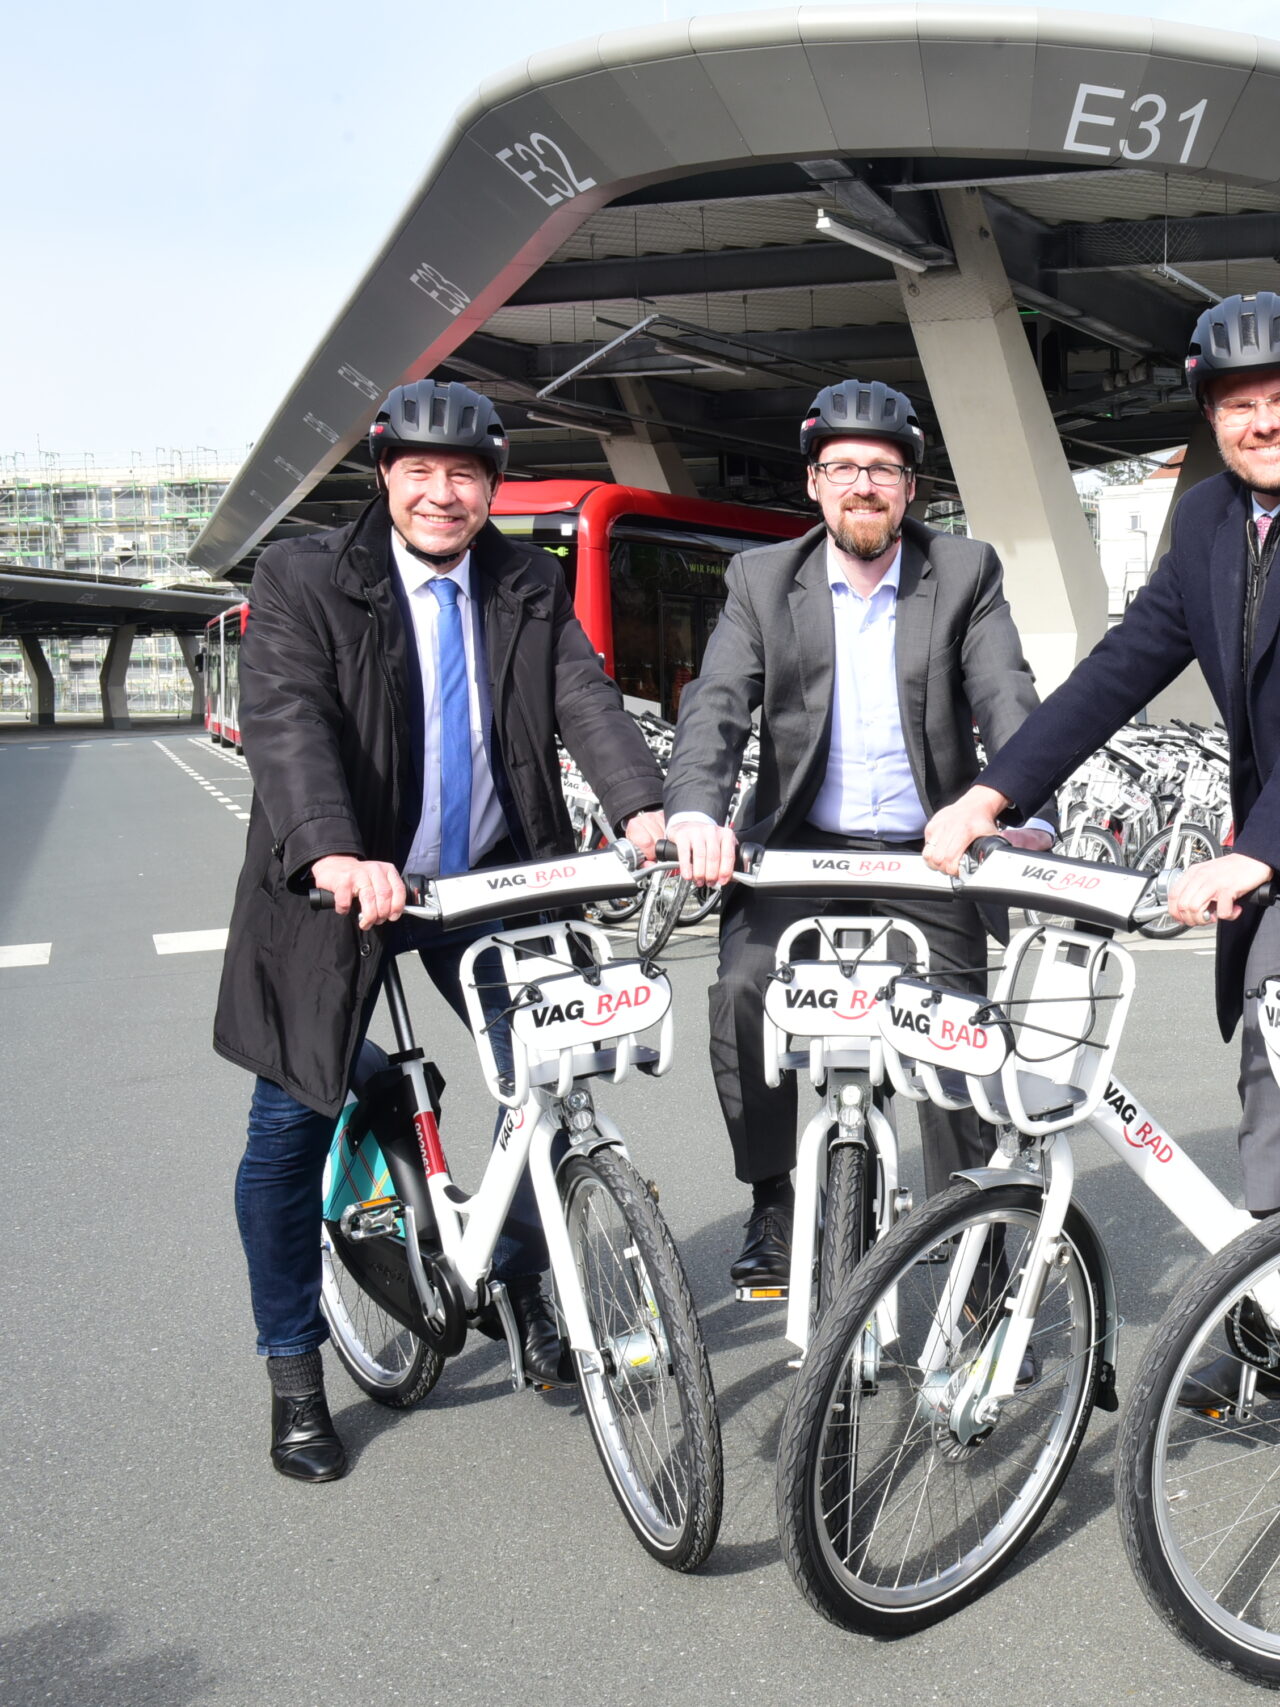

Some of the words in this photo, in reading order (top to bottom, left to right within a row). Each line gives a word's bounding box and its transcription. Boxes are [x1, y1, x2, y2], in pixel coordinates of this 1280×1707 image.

[1063, 83, 1208, 164] E31
[495, 132, 598, 207] E32
[409, 262, 471, 316] E33
[337, 362, 383, 401] E34
[563, 780, 579, 790] VAG
[487, 874, 527, 890] VAG
[535, 866, 577, 883] RAD
[812, 859, 850, 870] VAG
[859, 860, 901, 872] RAD
[1021, 865, 1058, 881] VAG
[1060, 873, 1101, 889] RAD
[531, 1000, 584, 1028] VAG
[597, 985, 651, 1015] RAD
[785, 989, 838, 1009] VAG
[889, 1005, 930, 1035] VAG
[941, 1019, 988, 1049] RAD
[499, 1113, 514, 1152] VAG
[1103, 1081, 1137, 1125] VAG
[1135, 1121, 1173, 1163] RAD
